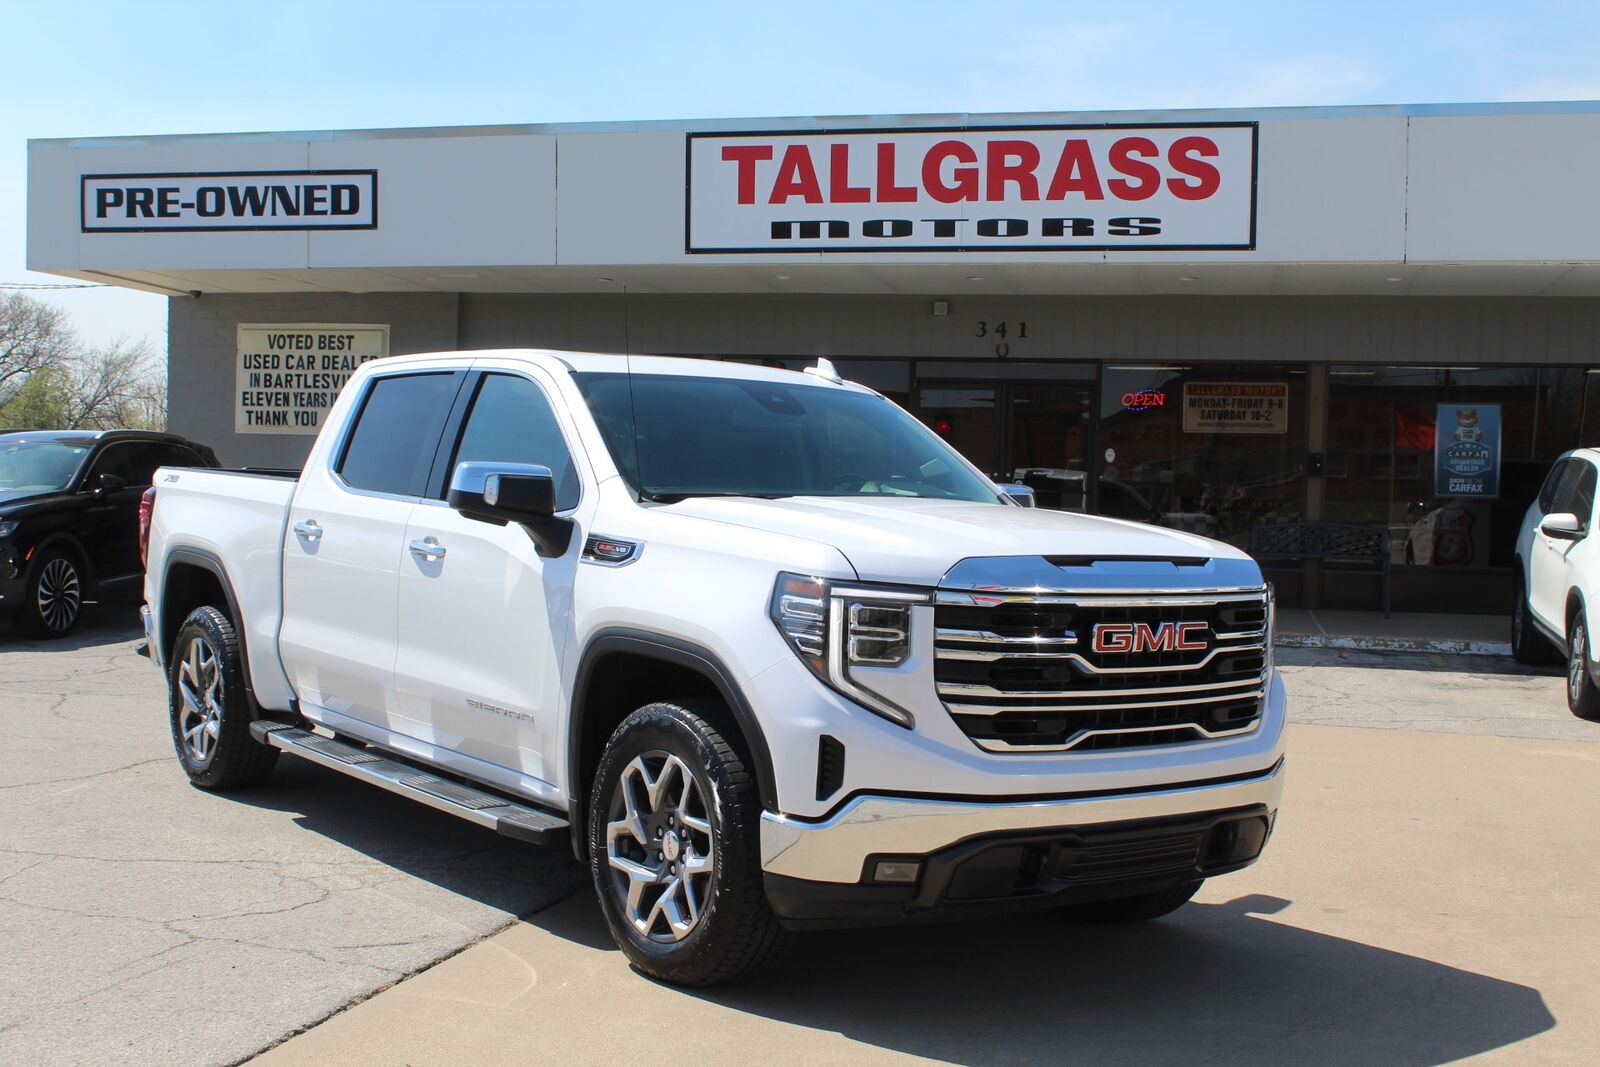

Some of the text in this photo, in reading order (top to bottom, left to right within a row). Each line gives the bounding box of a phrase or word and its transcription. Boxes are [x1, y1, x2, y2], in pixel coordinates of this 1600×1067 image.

[721, 136, 1221, 205] TALLGRASS
[96, 184, 360, 218] PRE-OWNED
[771, 217, 1162, 240] MOTORS
[267, 334, 355, 351] VOTED BEST
[243, 354, 280, 370] USED
[285, 354, 316, 370] CAR
[249, 373, 350, 389] IN BARTLESVI
[242, 391, 290, 407] ELEVEN
[293, 392, 328, 408] YEARS
[1121, 392, 1166, 407] OPEN
[246, 410, 318, 426] THANK YOU
[1200, 410, 1247, 421] SATURDAY
[1449, 484, 1483, 492] CARFAX
[1092, 621, 1208, 653] GMC
